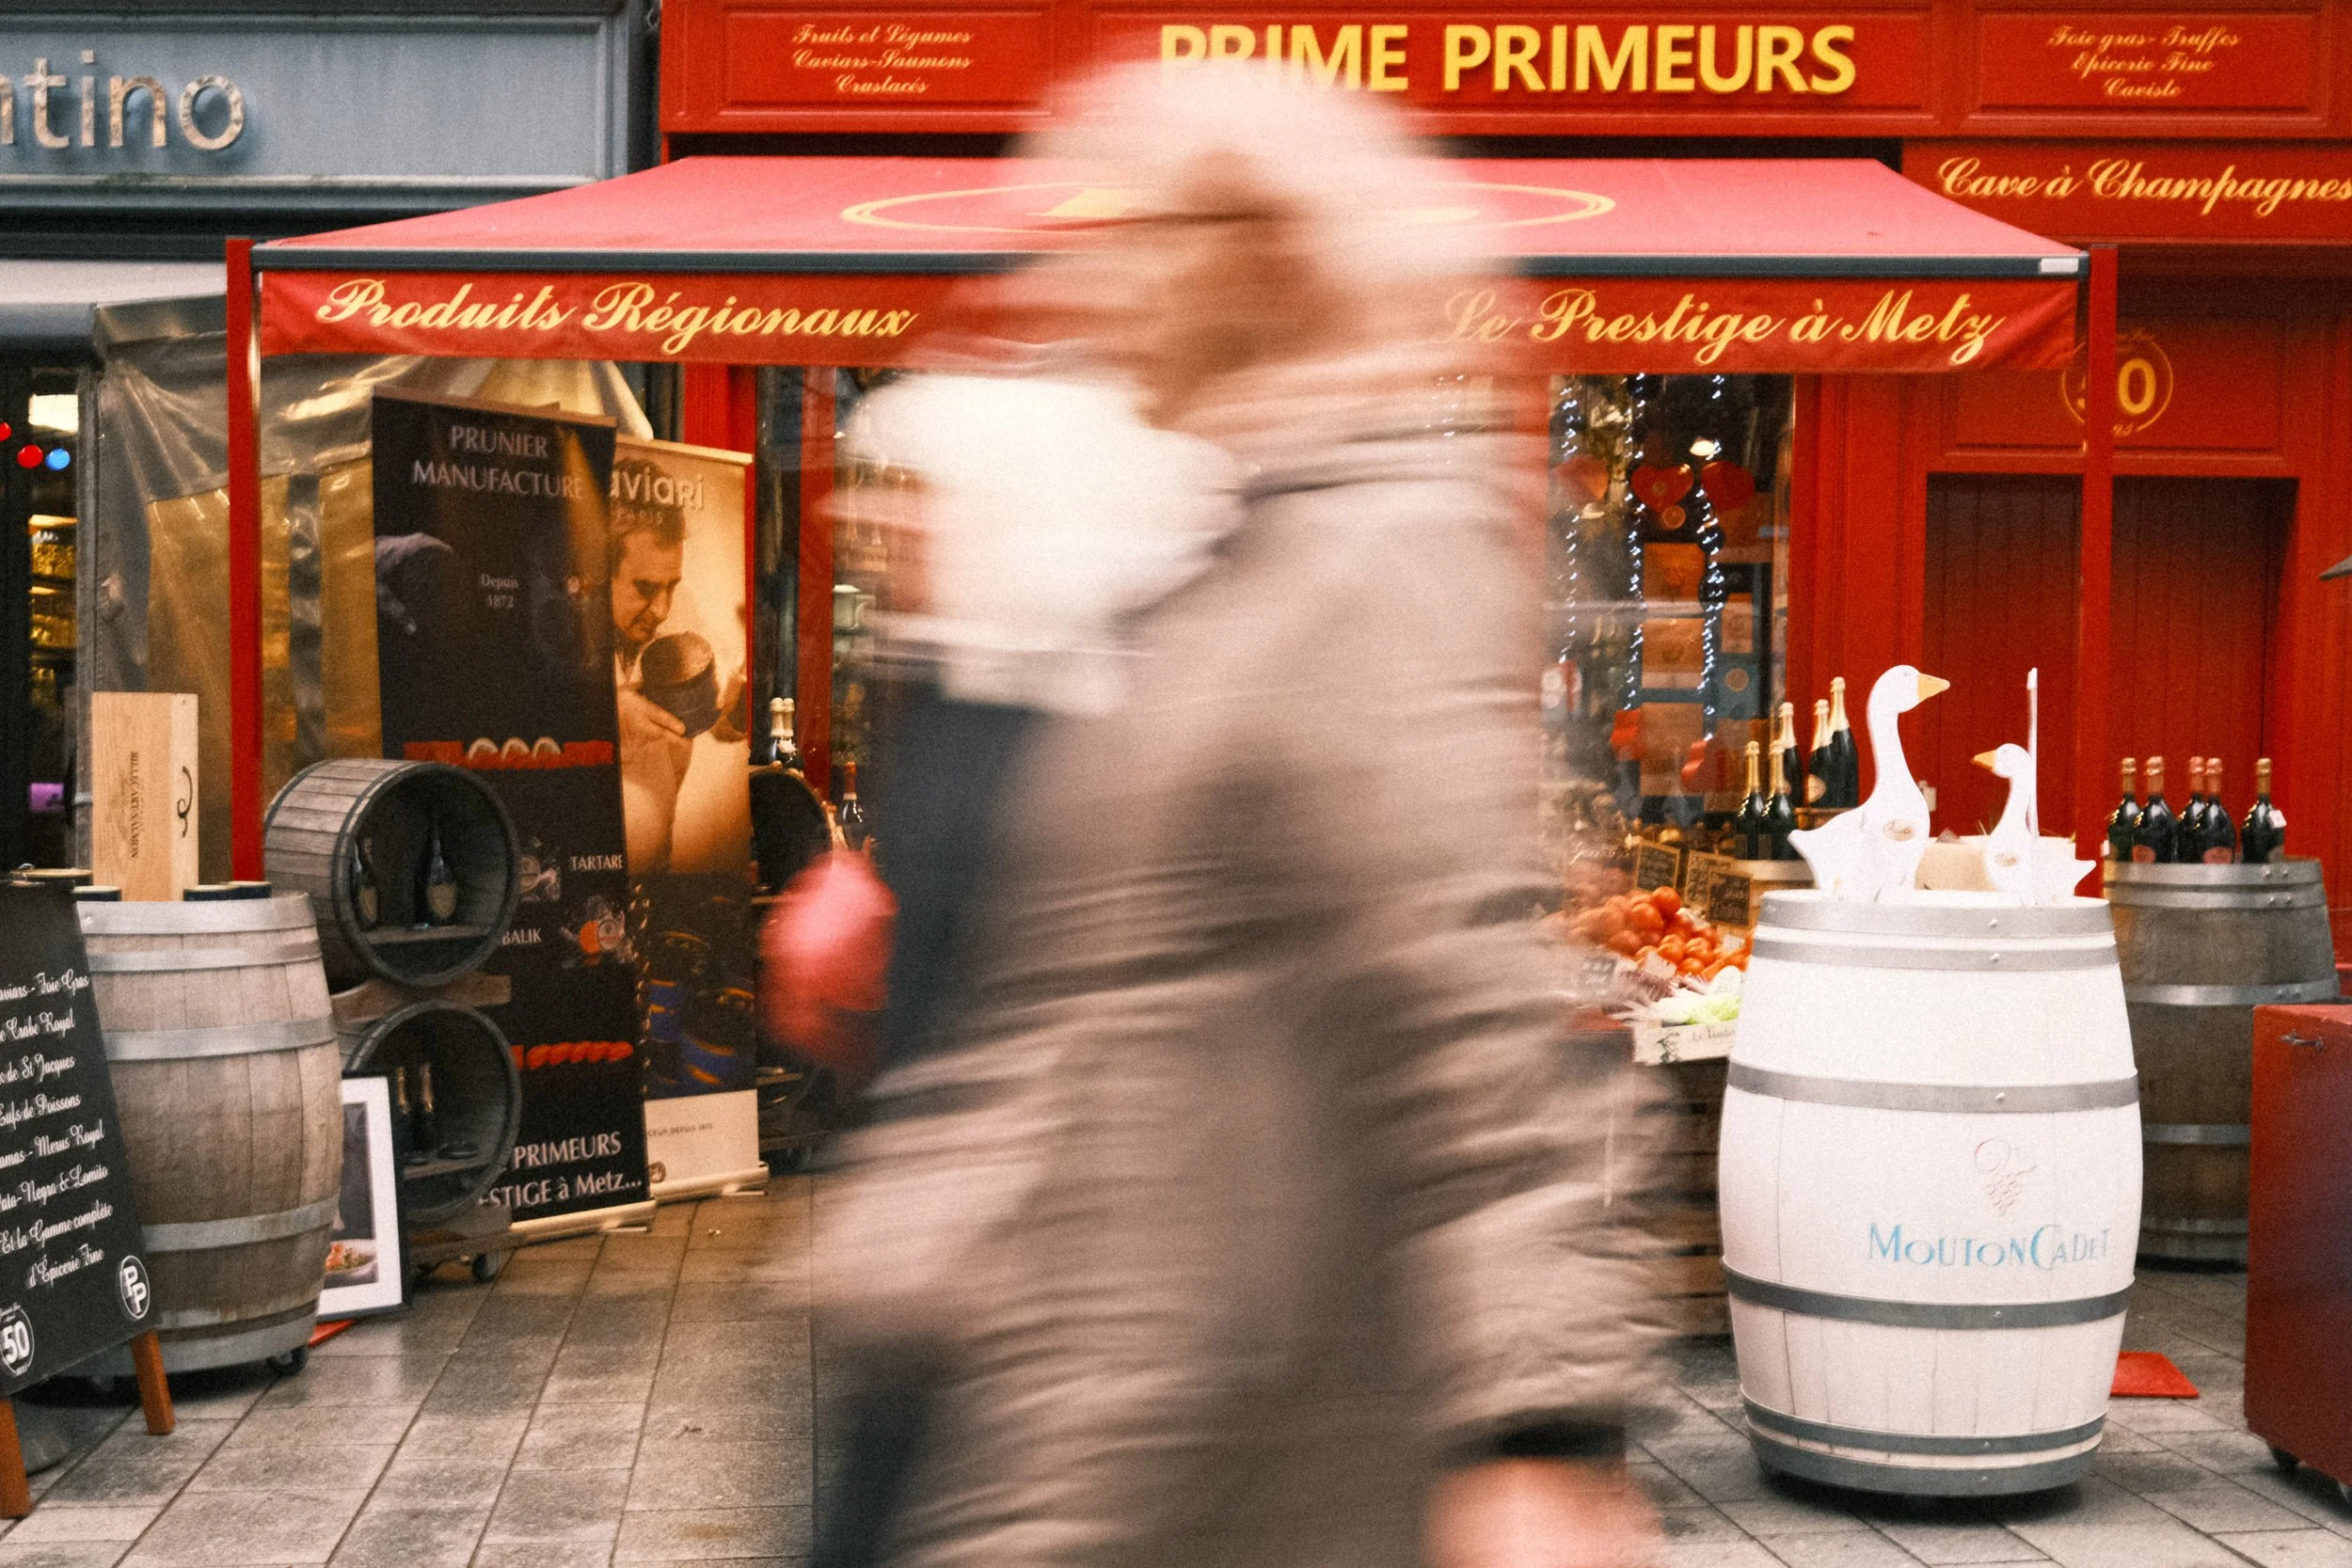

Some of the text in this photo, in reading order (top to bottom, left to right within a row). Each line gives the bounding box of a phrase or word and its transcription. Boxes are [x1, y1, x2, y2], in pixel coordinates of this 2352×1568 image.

[792, 23, 972, 50] Fruits et Légumes
[2047, 25, 2097, 46] Foie
[2162, 25, 2241, 53] Truffes
[1161, 24, 1856, 93] PRIME PRIMEURS
[2161, 51, 2214, 71] Fine
[835, 73, 930, 93] Crustacés
[2105, 77, 2182, 97] Caviste
[1939, 157, 2352, 217] Cave à Champagnes
[315, 277, 2007, 367] Produits Régionaux Le Prestige à Metz
[450, 425, 548, 459] PRUNIER
[412, 458, 586, 500] MANUFACTURE
[617, 507, 664, 526] PARIS
[481, 573, 519, 591] Depuis
[570, 853, 625, 871] TARTARE
[60, 968, 89, 996] Gras
[6, 1017, 40, 1039] Crabe
[40, 1007, 75, 1037] Royal
[34, 1053, 75, 1082] Jacques
[23, 1099, 35, 1119] de
[35, 1093, 81, 1116] Poissons
[34, 1135, 71, 1157] Merus
[70, 1118, 104, 1148] Royal
[514, 1132, 622, 1169] PRIMEURS
[69, 1164, 108, 1187] Lomito
[558, 1176, 569, 1200] à
[16, 1227, 28, 1248] la
[29, 1219, 72, 1248] Gamme
[79, 1243, 104, 1265] Fine
[2, 1321, 30, 1364] 50
